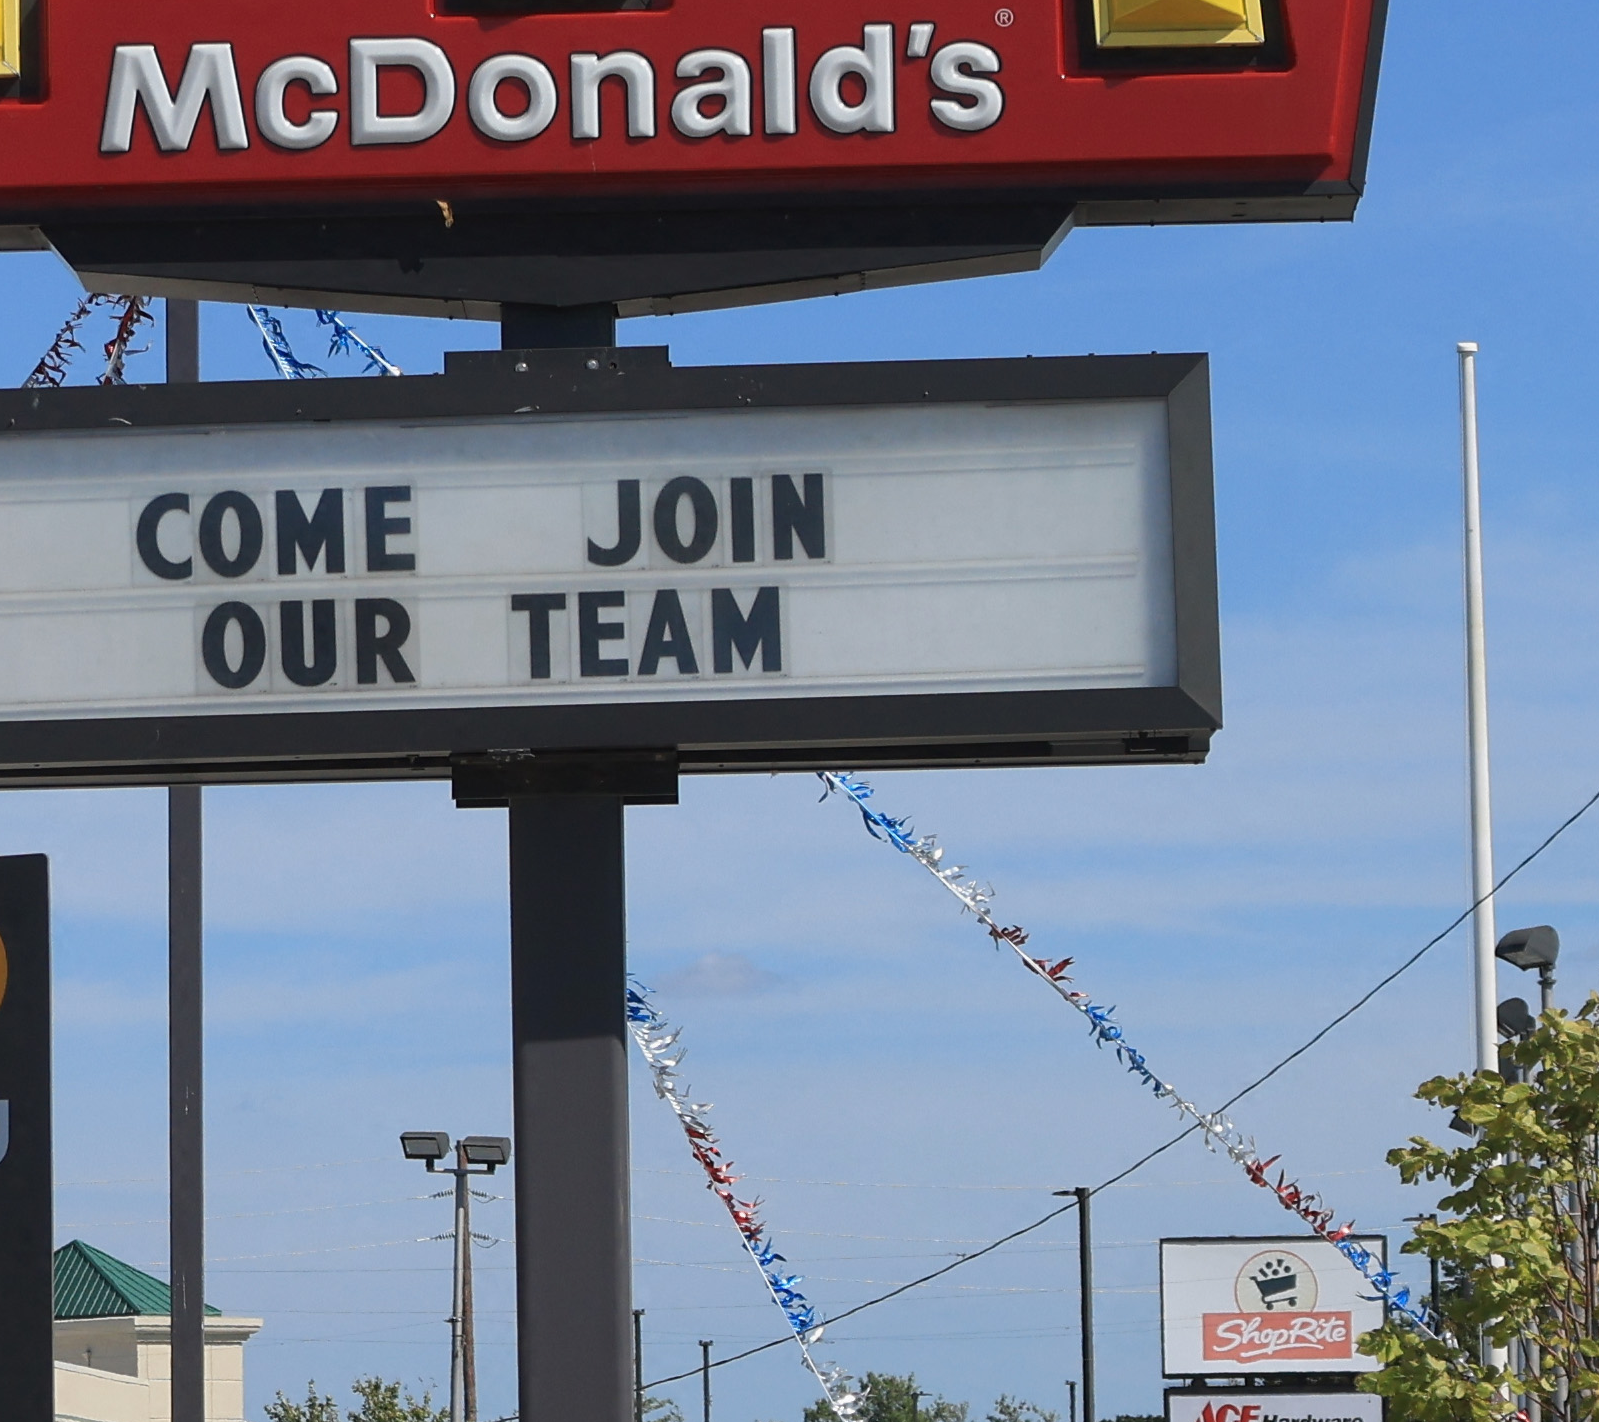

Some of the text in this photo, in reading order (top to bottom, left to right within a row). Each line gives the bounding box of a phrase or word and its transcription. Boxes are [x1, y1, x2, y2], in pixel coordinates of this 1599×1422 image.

[100, 21, 1006, 154] McDonald's
[136, 473, 824, 579] COME JOIN
[201, 586, 782, 690] OUR TEAM
[1213, 1317, 1347, 1355] ShopRite
